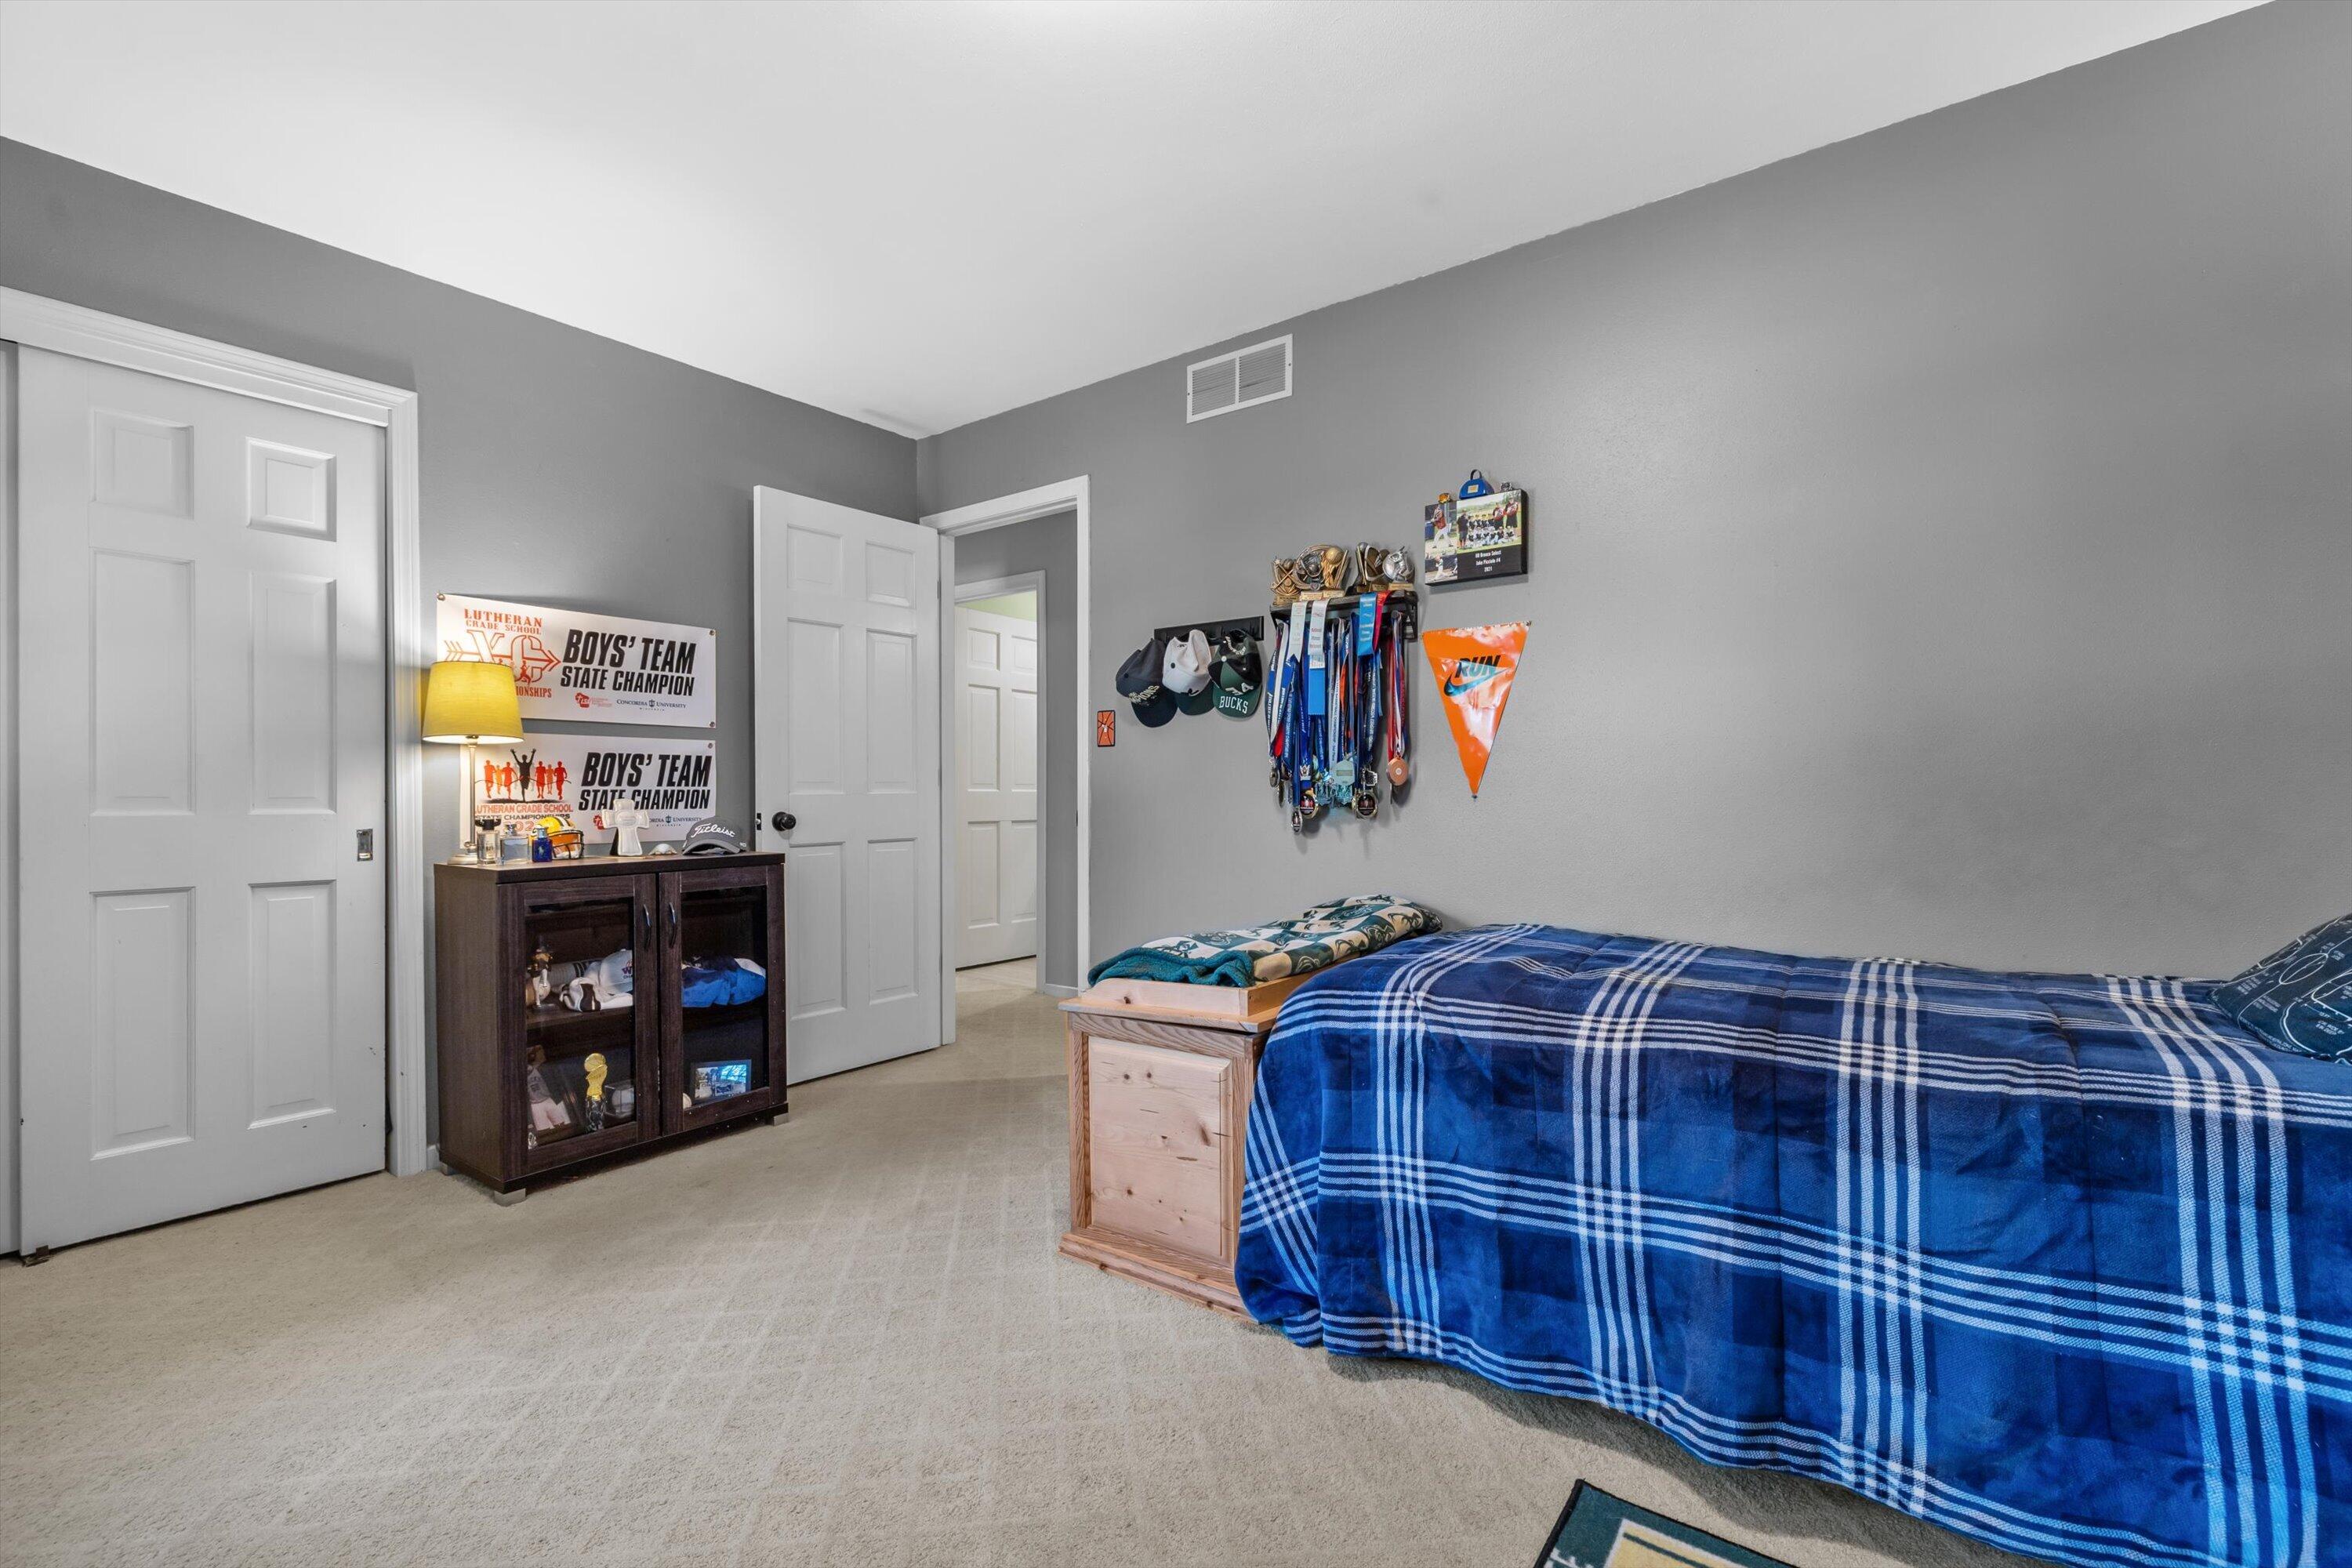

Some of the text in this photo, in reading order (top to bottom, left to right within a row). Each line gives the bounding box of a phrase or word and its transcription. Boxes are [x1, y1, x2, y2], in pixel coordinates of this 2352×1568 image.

[464, 608, 543, 628] LUTHERAN
[466, 619, 542, 635] GRADE SCHOOL
[562, 629, 696, 674] BOYS' TEAM
[1454, 655, 1501, 678] RUN
[560, 666, 695, 696] STATE CHAMPION
[516, 685, 552, 699] IONSHIPS
[1219, 696, 1248, 714] BUCKS
[581, 752, 713, 787] BOYS' TEAM
[474, 804, 574, 814] UTHERAN GRADE SCHOOL
[631, 789, 711, 811] CHAMPION
[691, 822, 735, 838] Titleist
